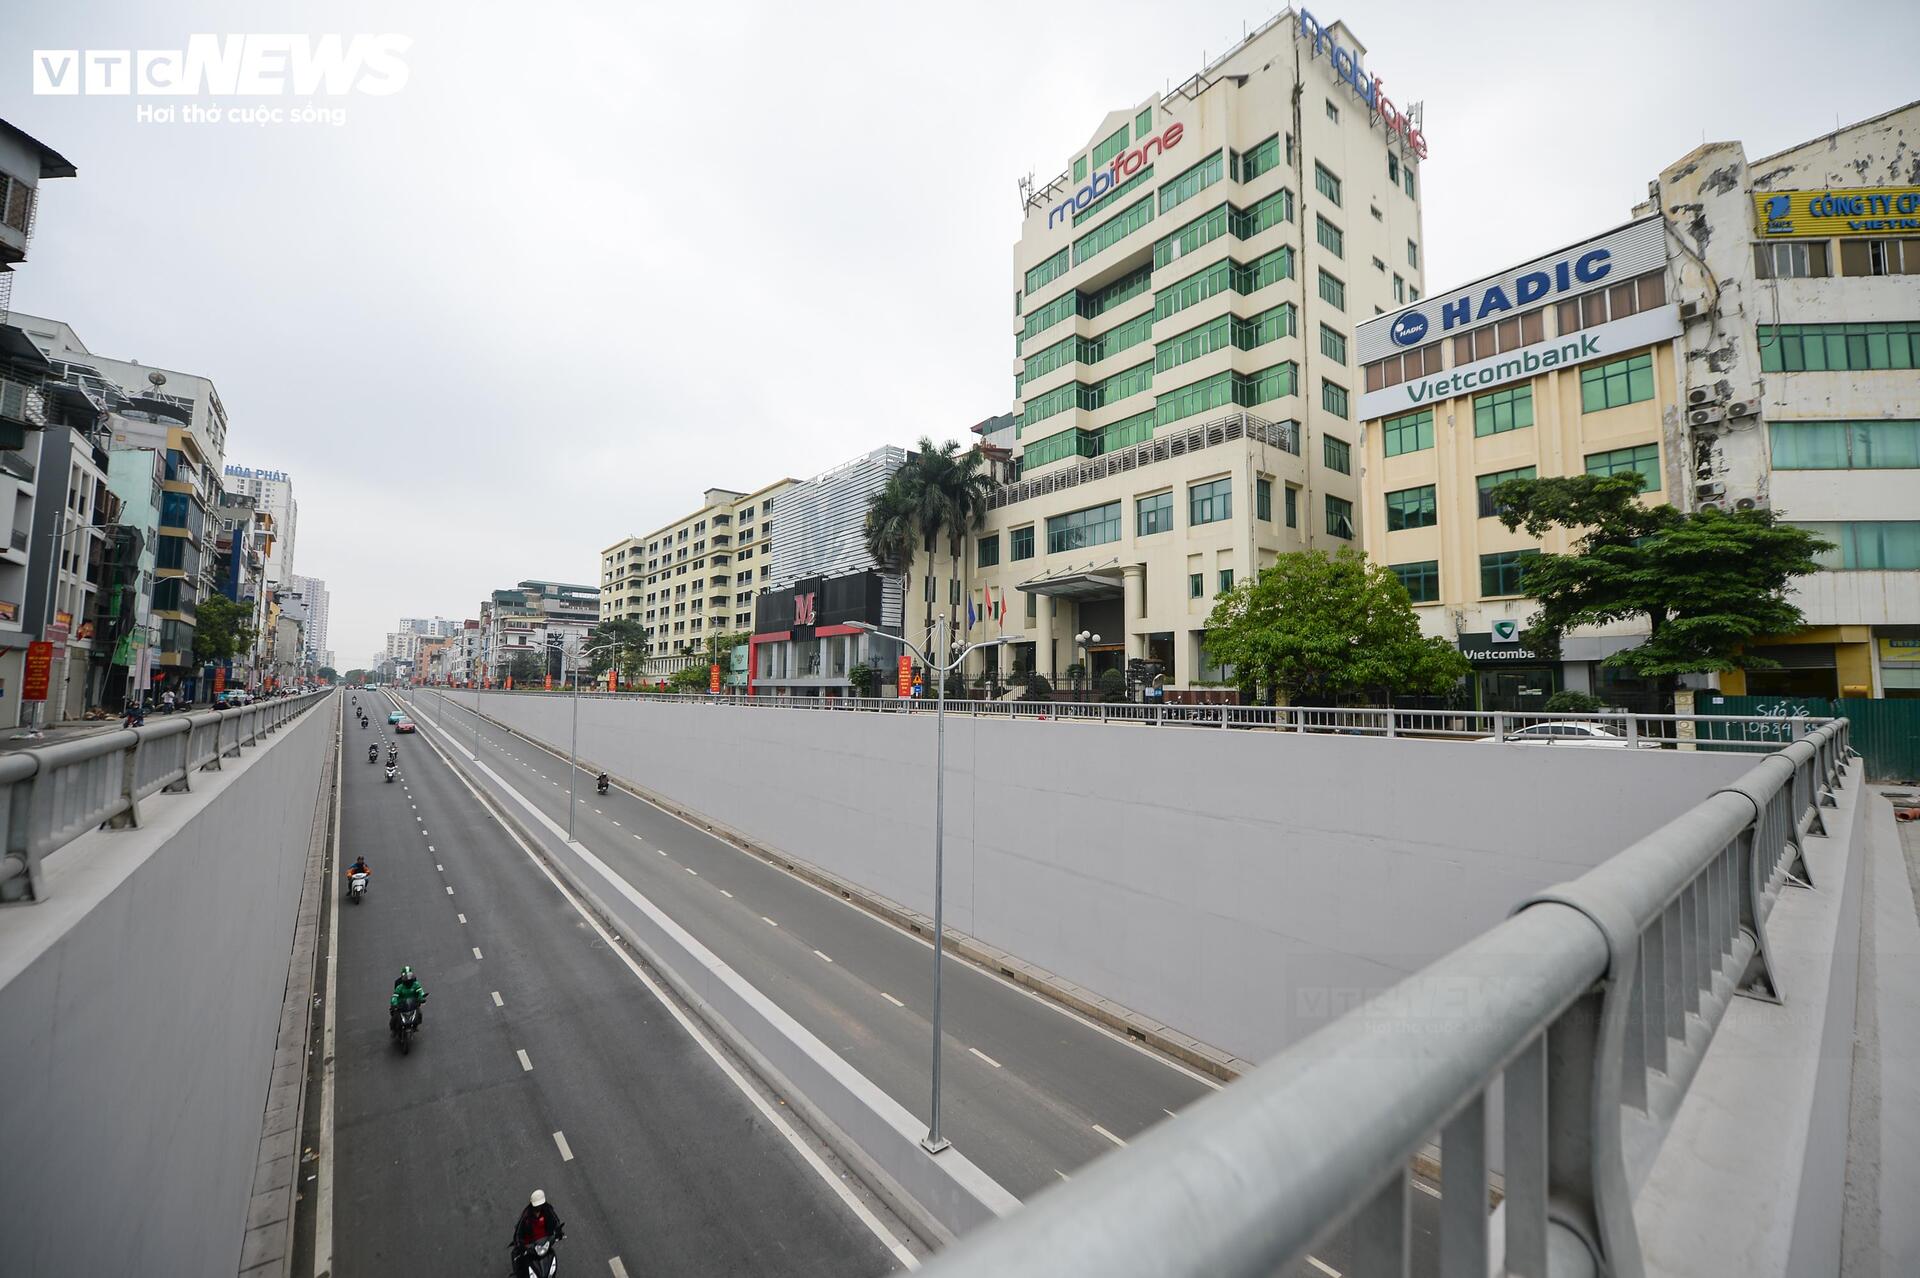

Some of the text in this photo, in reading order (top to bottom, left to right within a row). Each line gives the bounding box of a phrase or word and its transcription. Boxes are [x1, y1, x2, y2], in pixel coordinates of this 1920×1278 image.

[1301, 7, 1428, 161] mobifone
[1048, 121, 1185, 230] mobifone
[1809, 192, 1865, 217] CÔNG
[1868, 194, 1893, 214] TY
[1849, 218, 1920, 230] VIETN
[1442, 248, 1612, 330] HADIC
[1399, 323, 1424, 338] HADIC
[1407, 332, 1602, 403] Vietcombank
[1463, 648, 1546, 660] Vietcomba
